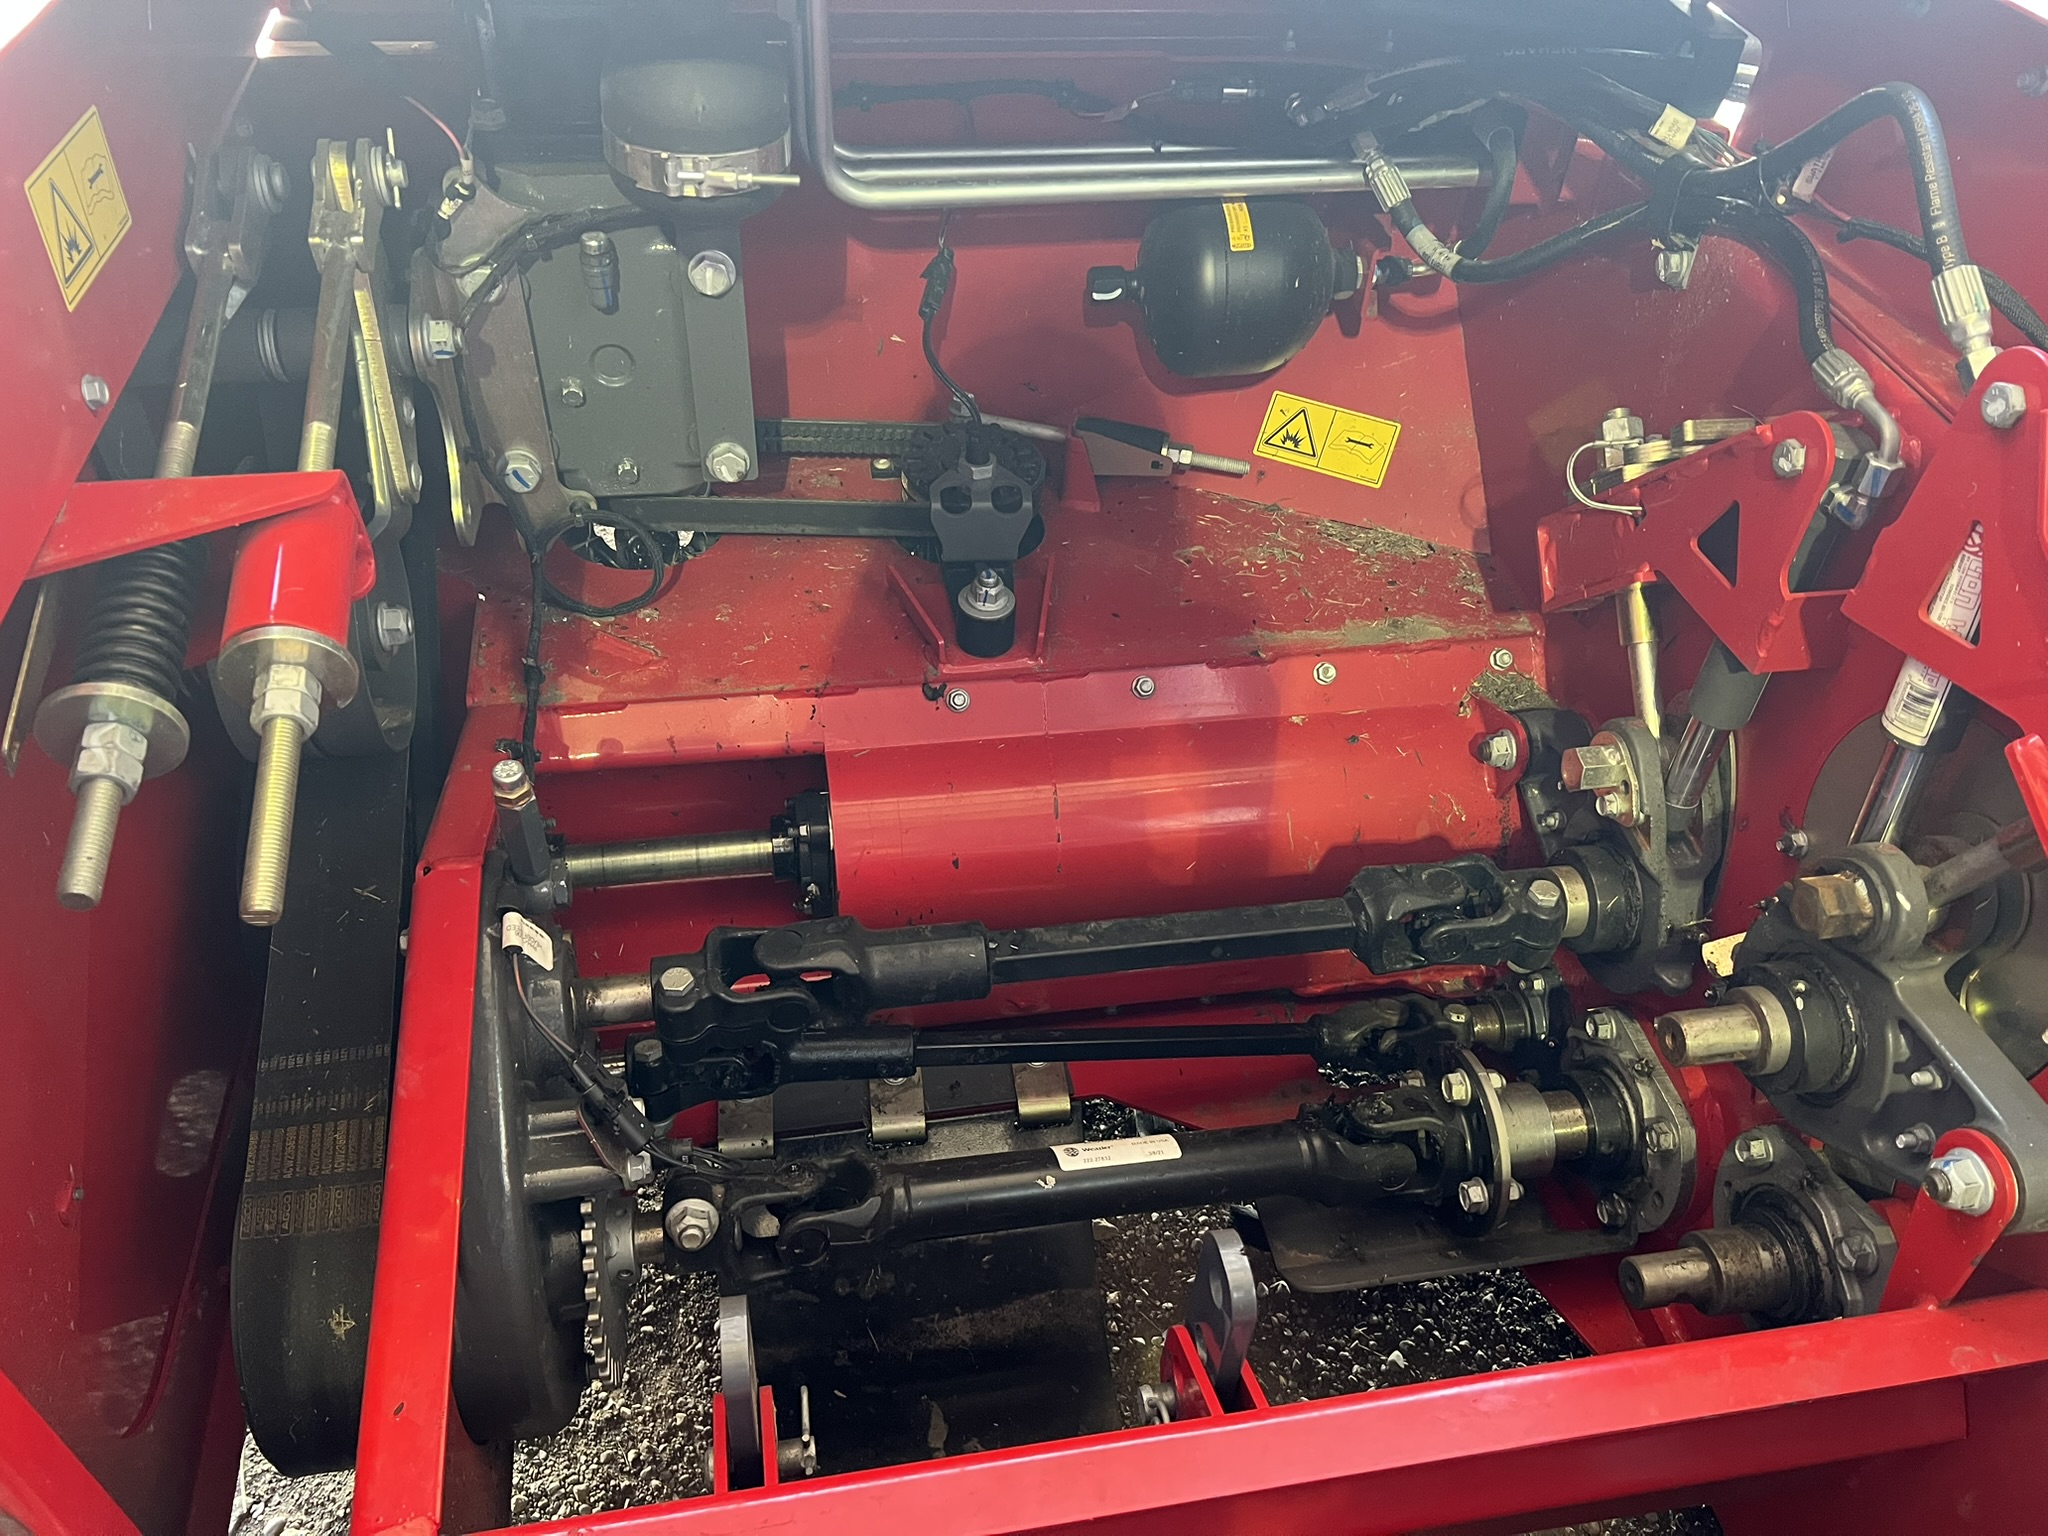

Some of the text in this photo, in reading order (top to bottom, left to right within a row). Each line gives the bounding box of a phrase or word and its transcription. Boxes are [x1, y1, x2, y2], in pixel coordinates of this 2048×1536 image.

[1918, 134, 1937, 183] Resistant
[1930, 184, 1943, 216] Flame
[1935, 234, 1949, 245] B
